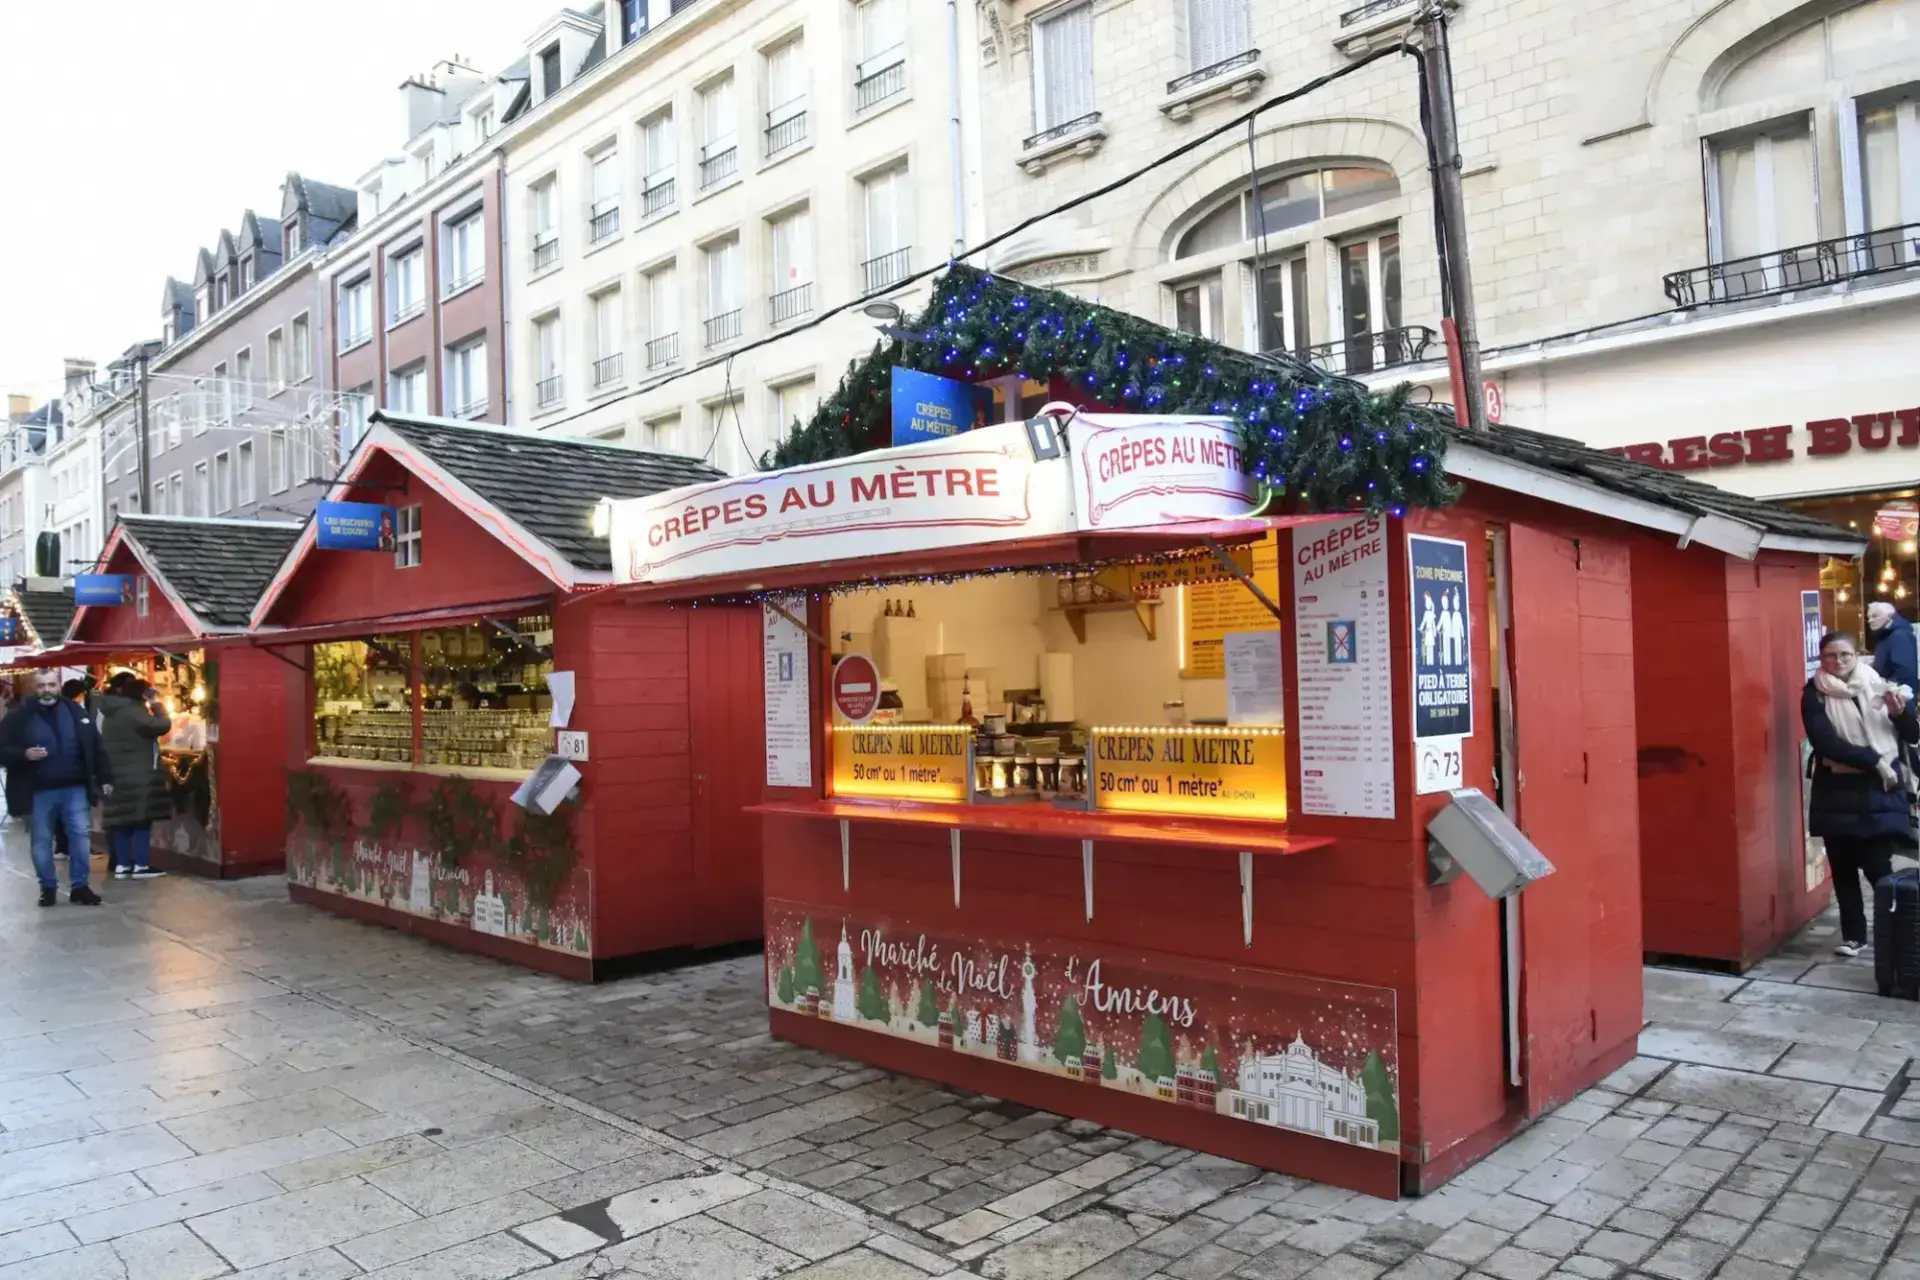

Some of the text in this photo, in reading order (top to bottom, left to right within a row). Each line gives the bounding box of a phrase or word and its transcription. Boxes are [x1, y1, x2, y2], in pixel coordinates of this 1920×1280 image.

[916, 401, 952, 420] CRÊPES
[911, 417, 924, 431] AU
[1603, 421, 1793, 471] RESH
[1099, 437, 1166, 483] CRÊPES
[1171, 436, 1196, 464] AU
[648, 465, 1000, 547] CRÊPES AU MÈTRE
[1297, 514, 1380, 566] CRÊPES
[1139, 570, 1167, 581] SENS
[1174, 567, 1190, 577] de
[1195, 565, 1206, 575] la
[1303, 537, 1382, 586] AU MÈTRE
[1415, 565, 1434, 580] ZONE
[1418, 668, 1468, 690] PIED À TERRE
[1418, 689, 1469, 706] OBLIGATOIRE
[574, 739, 585, 754] 81
[898, 733, 914, 755] AU
[1098, 734, 1155, 763] CRÊPES
[1161, 737, 1185, 764] AU
[854, 764, 864, 780] 50
[884, 768, 896, 781] ou
[901, 765, 906, 781] 1
[1443, 751, 1460, 777] 73
[1100, 772, 1114, 792] 50
[1142, 777, 1158, 794] ou
[1166, 775, 1173, 794] 1
[1221, 789, 1231, 798] AU
[1233, 790, 1257, 800] CHOIX
[861, 929, 941, 973] Marché
[937, 970, 953, 994] de
[951, 951, 1013, 1000] Noël
